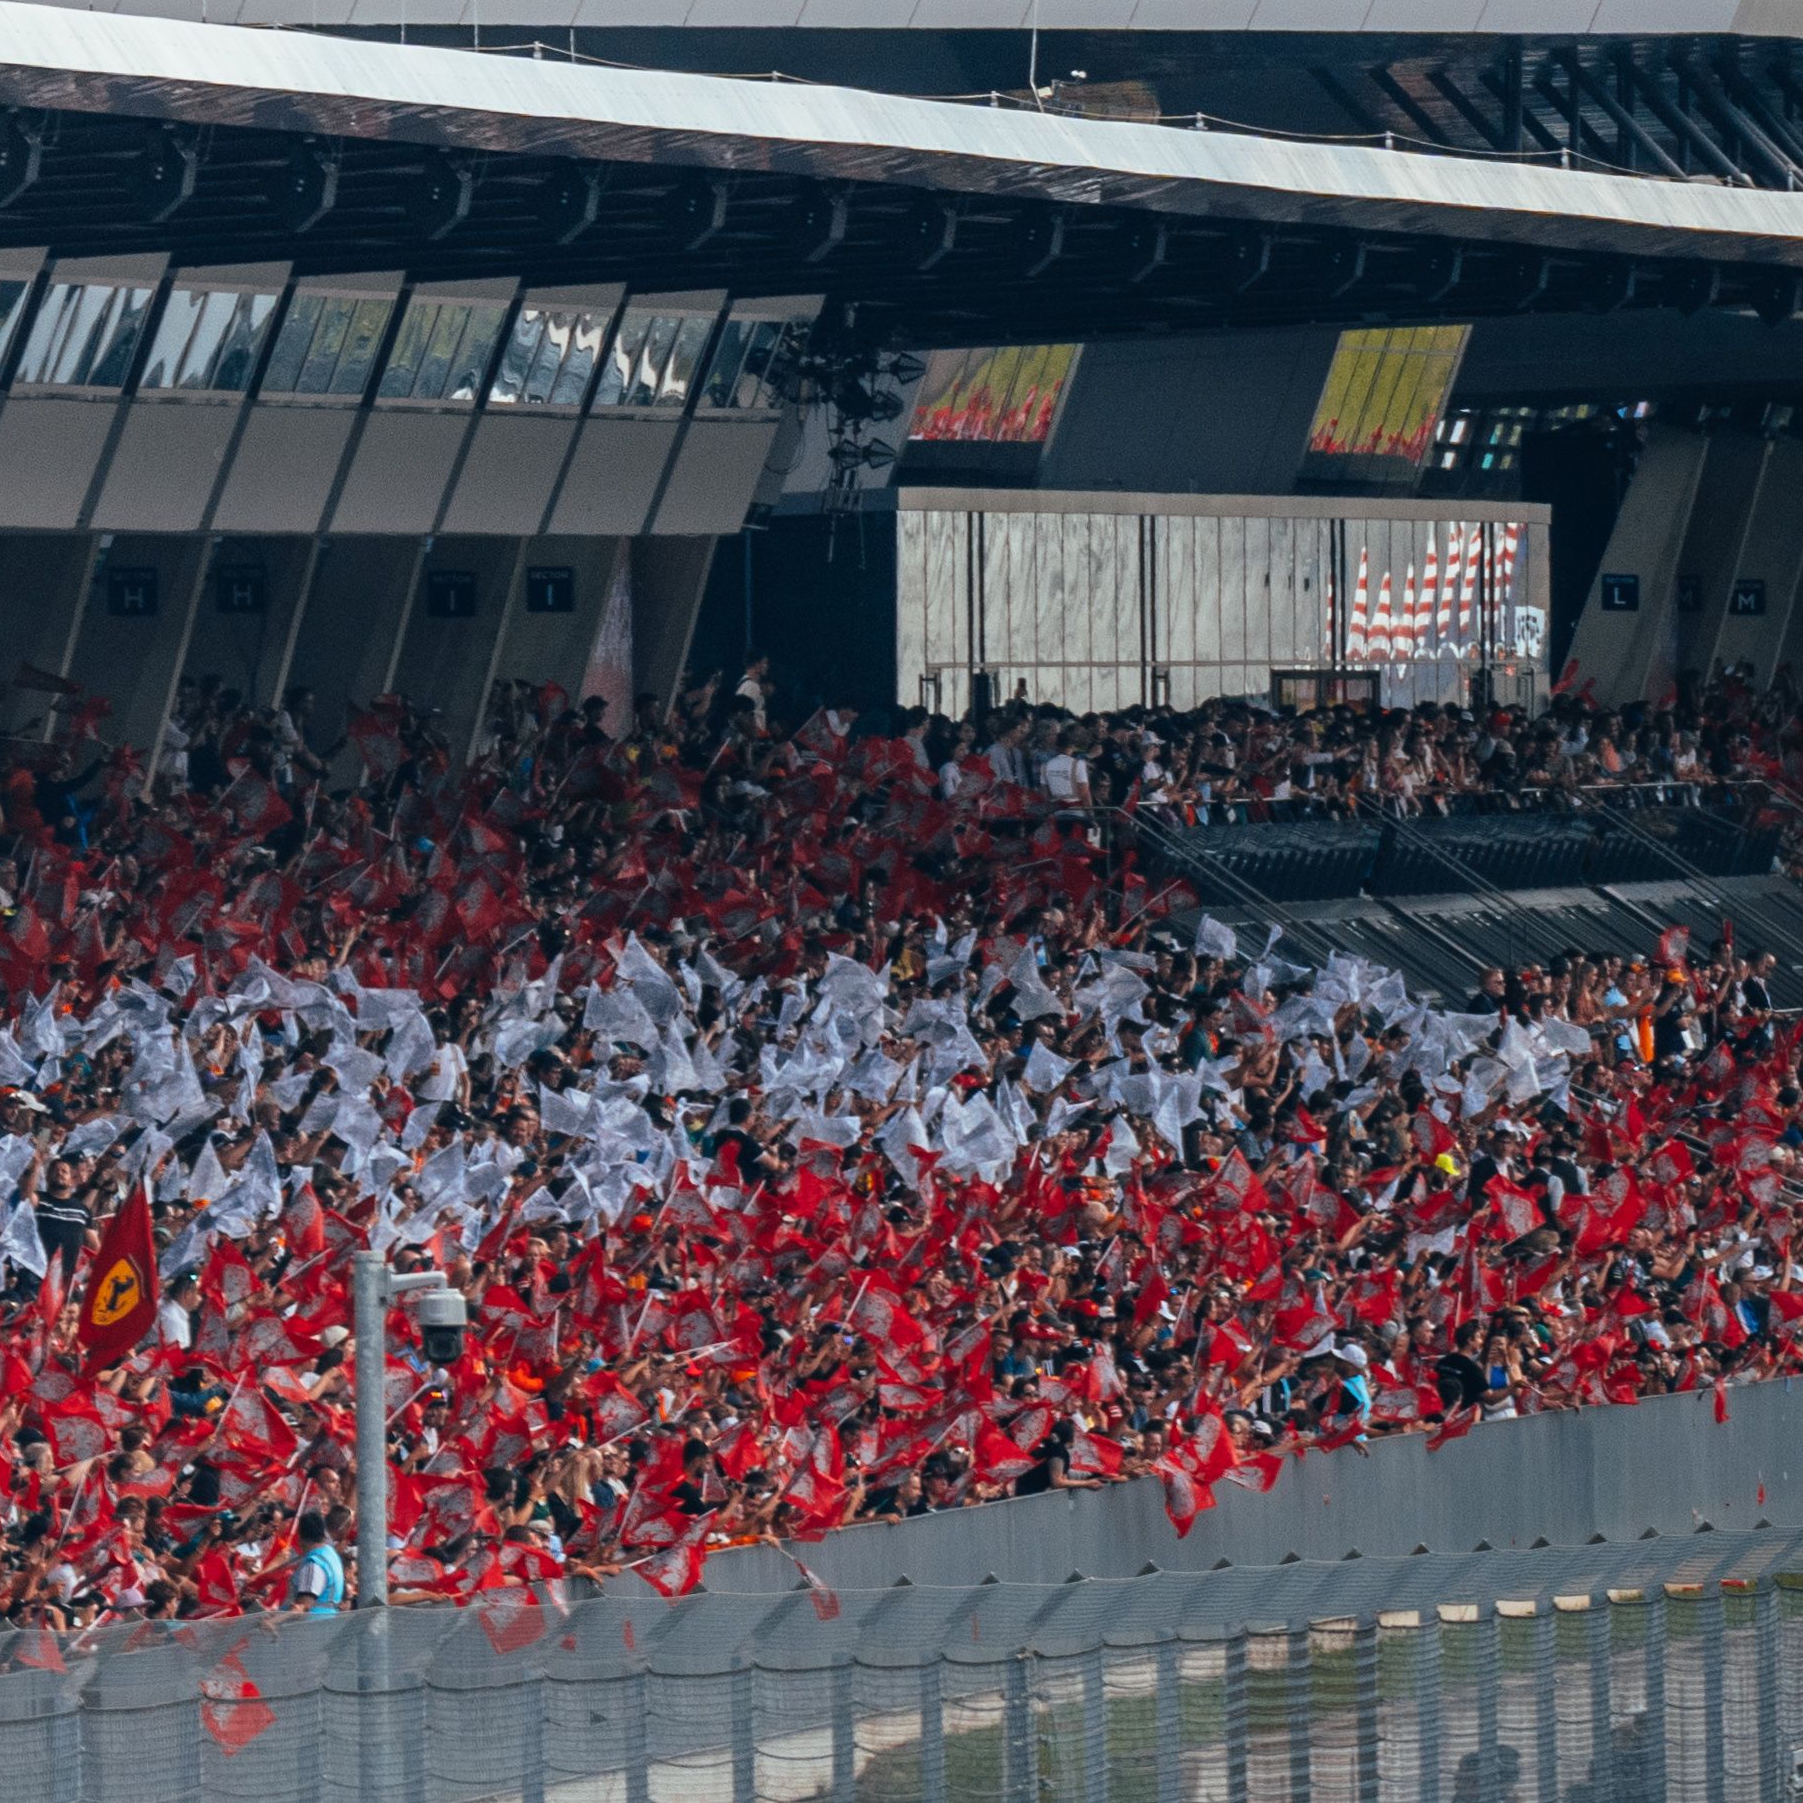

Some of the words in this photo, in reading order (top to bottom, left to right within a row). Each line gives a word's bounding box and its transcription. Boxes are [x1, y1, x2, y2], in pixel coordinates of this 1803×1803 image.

[124, 586, 143, 609] H
[233, 583, 251, 606] H
[1613, 587, 1626, 604] L
[1737, 593, 1755, 610] M
